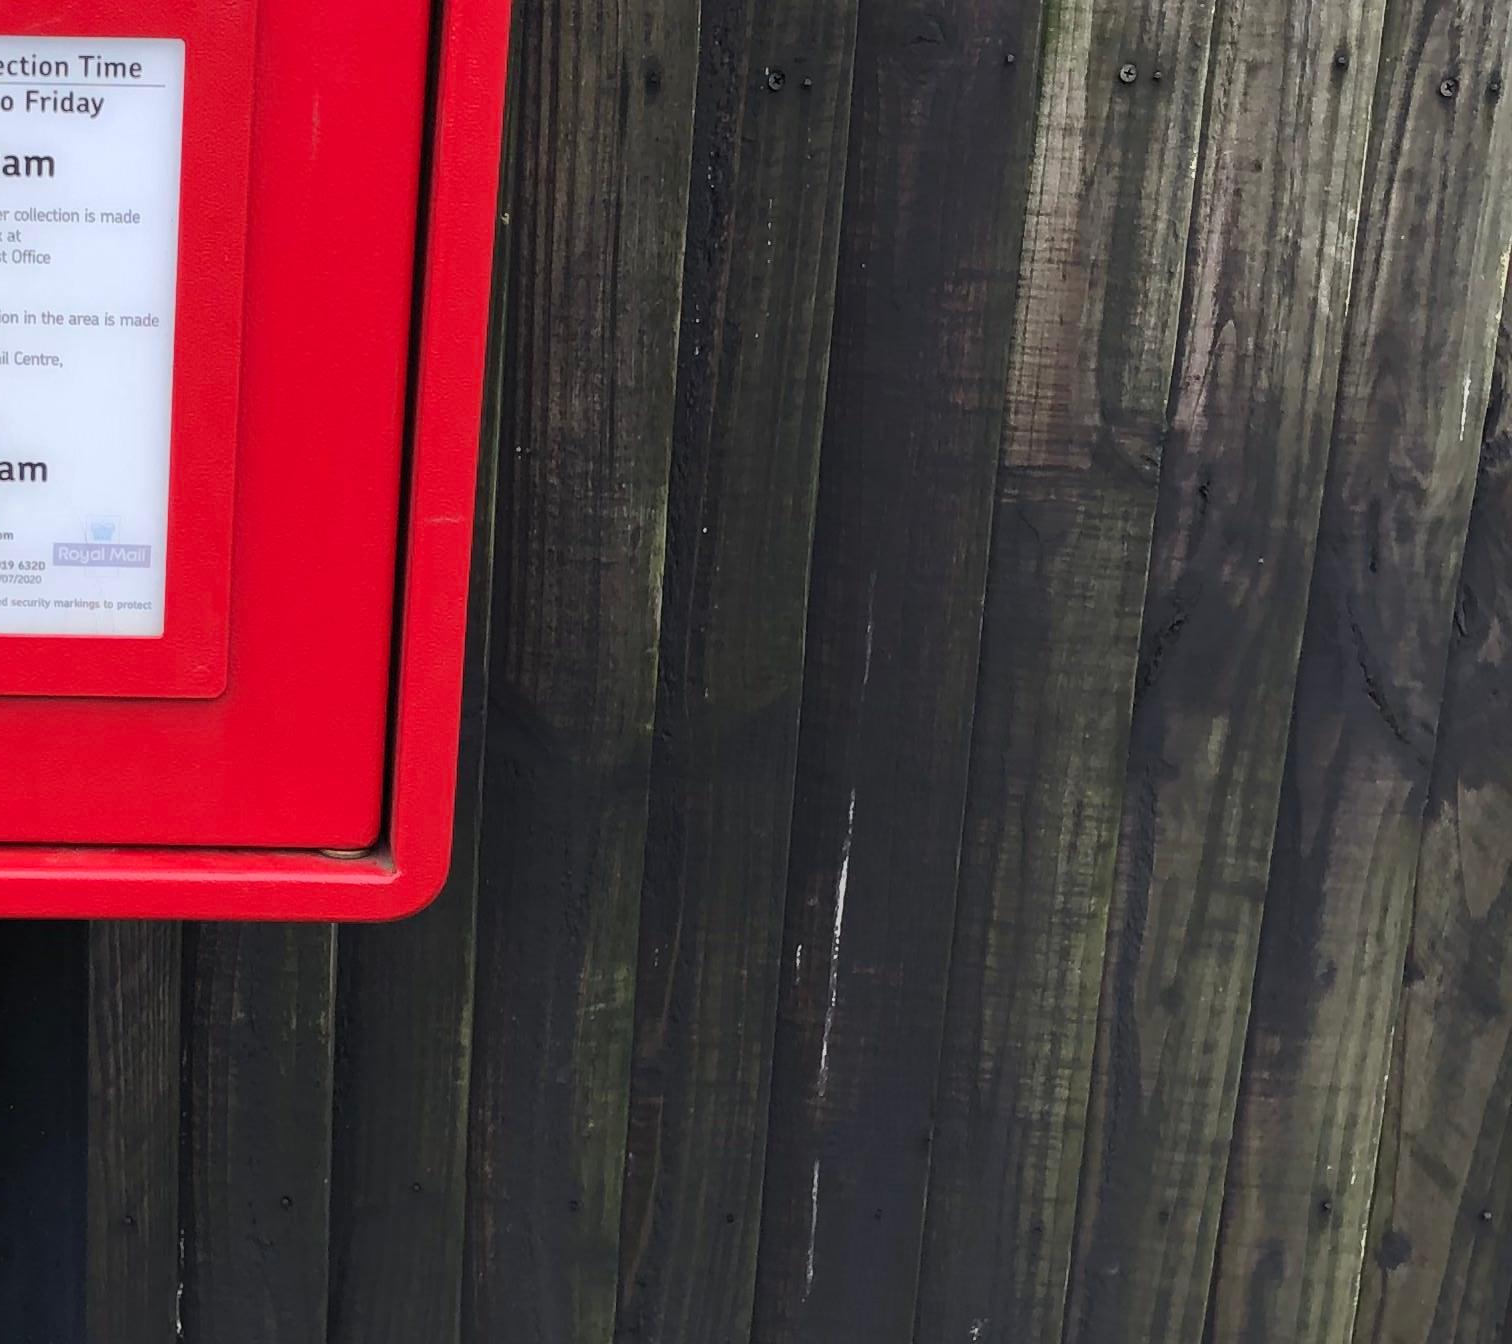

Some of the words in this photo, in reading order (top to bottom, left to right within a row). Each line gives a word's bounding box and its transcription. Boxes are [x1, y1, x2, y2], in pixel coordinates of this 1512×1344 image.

[79, 56, 143, 79] Time
[26, 91, 104, 118] Friday
[14, 208, 80, 223] collection
[85, 208, 95, 222] is
[100, 209, 141, 224] made
[7, 231, 21, 242] at
[12, 249, 51, 264] Office
[24, 311, 37, 325] in
[42, 311, 64, 325] the
[68, 315, 100, 326] area
[104, 312, 115, 326] is
[120, 313, 160, 327] made
[14, 352, 63, 368] Centre,
[58, 547, 105, 563] Royal
[110, 548, 146, 562] Mail
[12, 598, 50, 610] security
[54, 598, 100, 610] markings
[103, 599, 114, 609] to
[117, 599, 152, 611] protect
